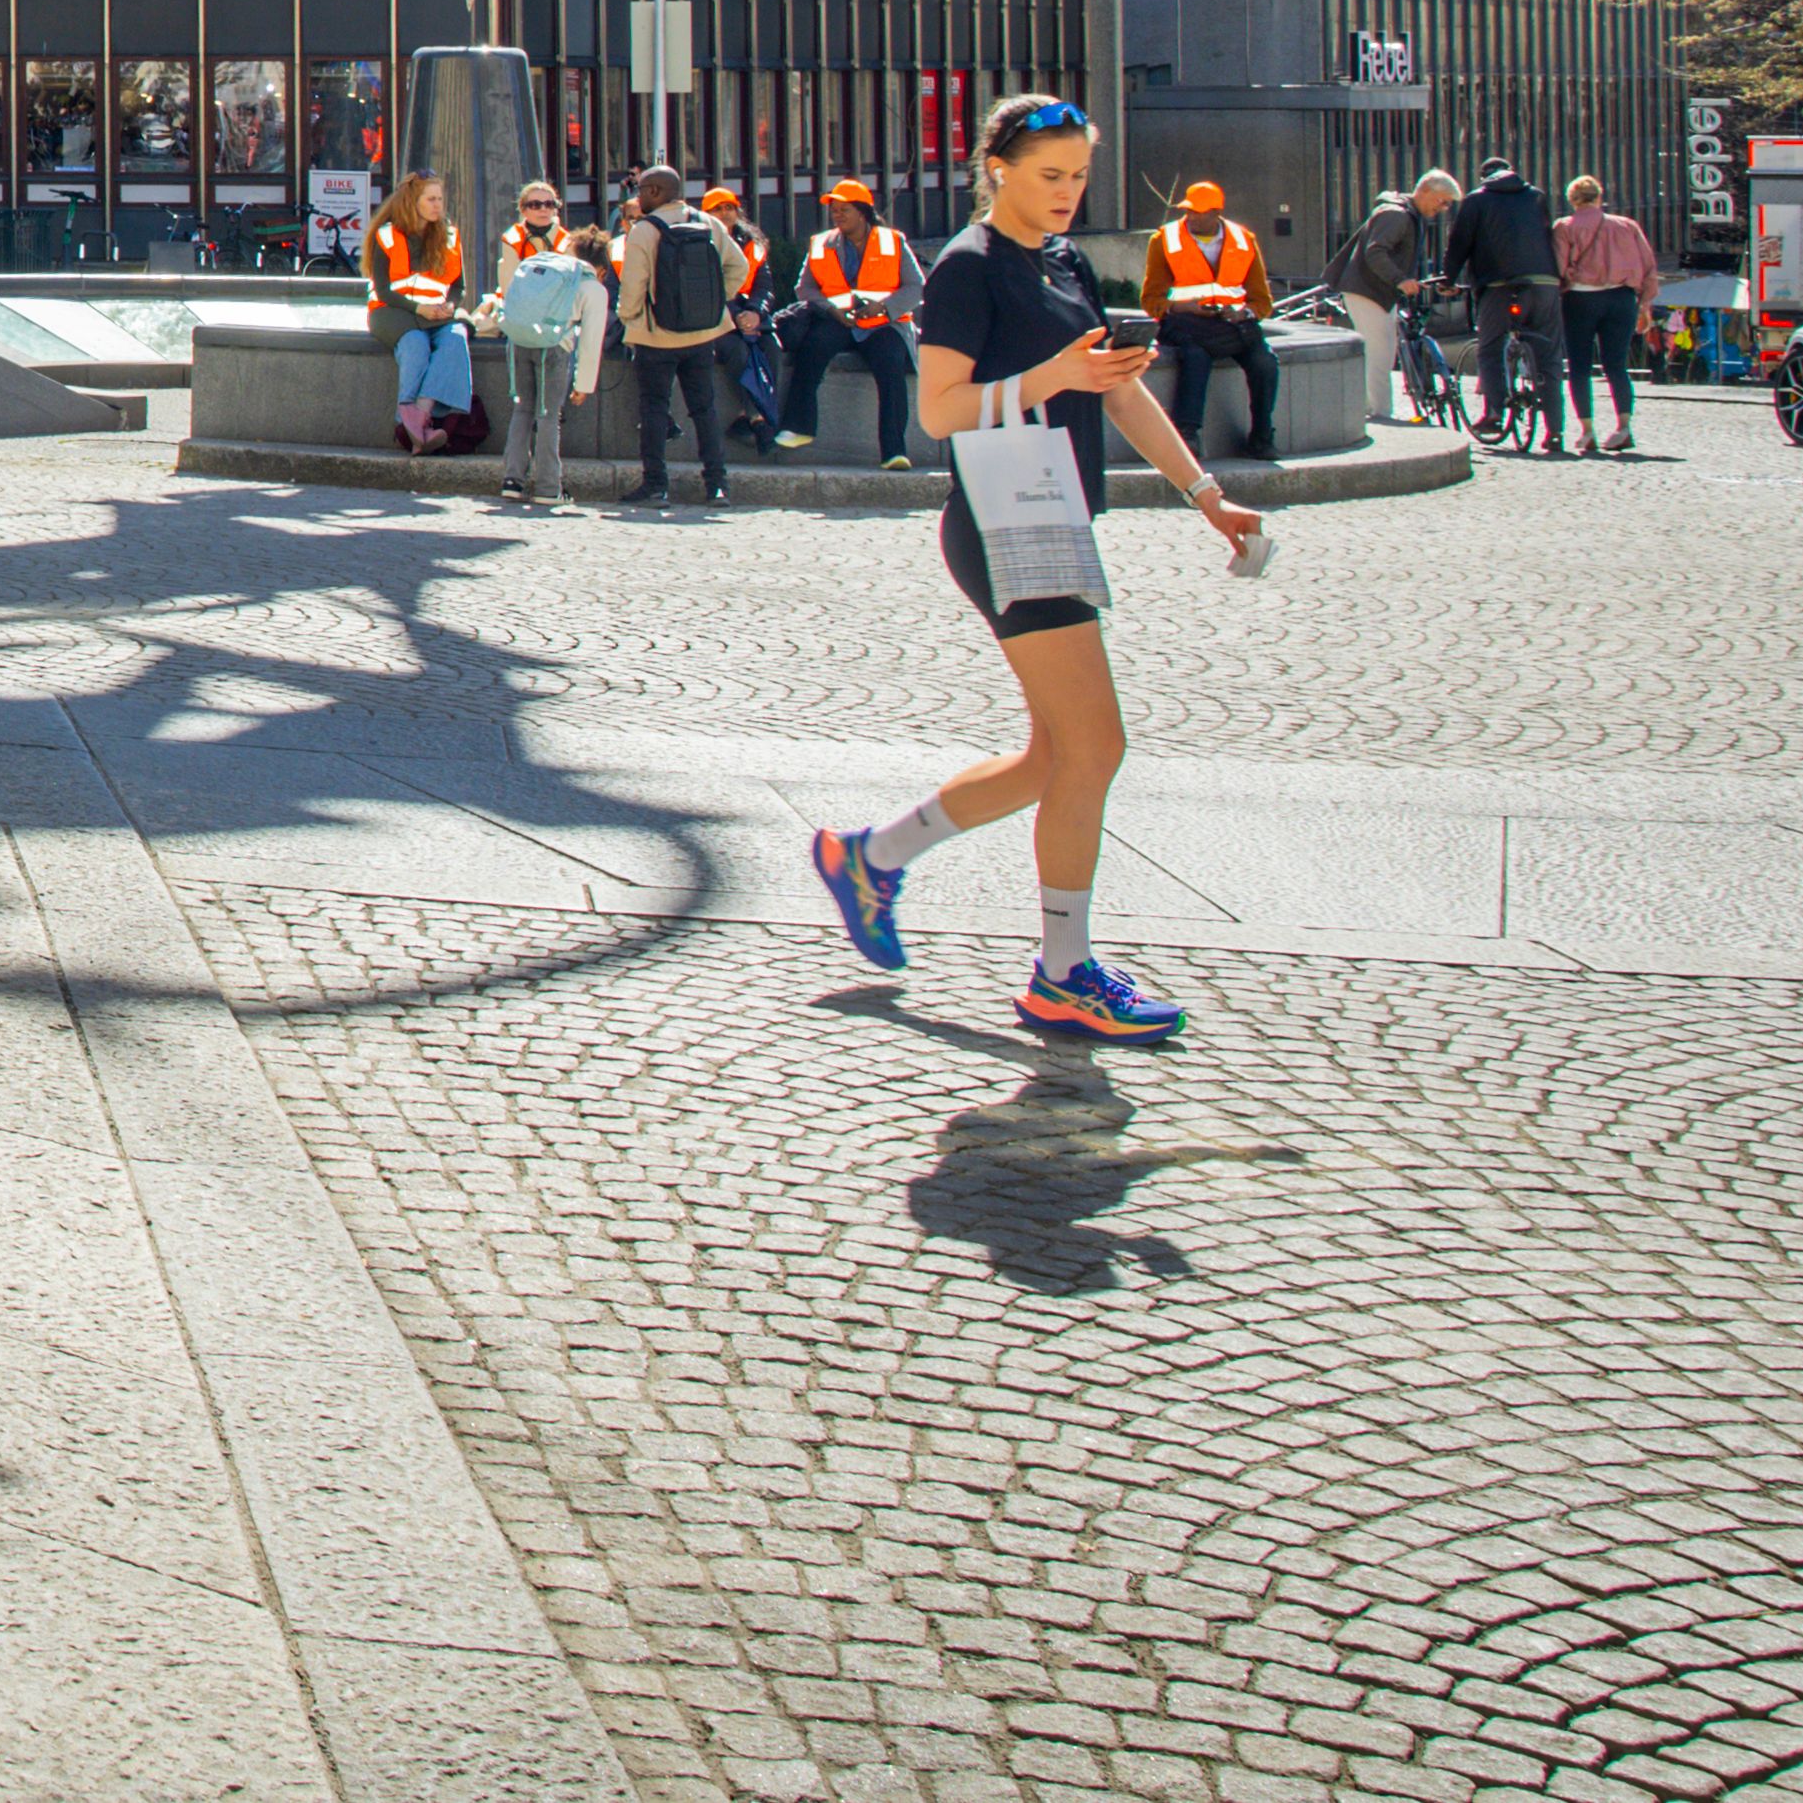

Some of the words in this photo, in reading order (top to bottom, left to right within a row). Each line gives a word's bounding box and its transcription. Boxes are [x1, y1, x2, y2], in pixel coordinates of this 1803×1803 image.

[1357, 30, 1412, 84] Rebel
[325, 179, 354, 188] BIKE
[1689, 97, 1734, 223] Rebel
